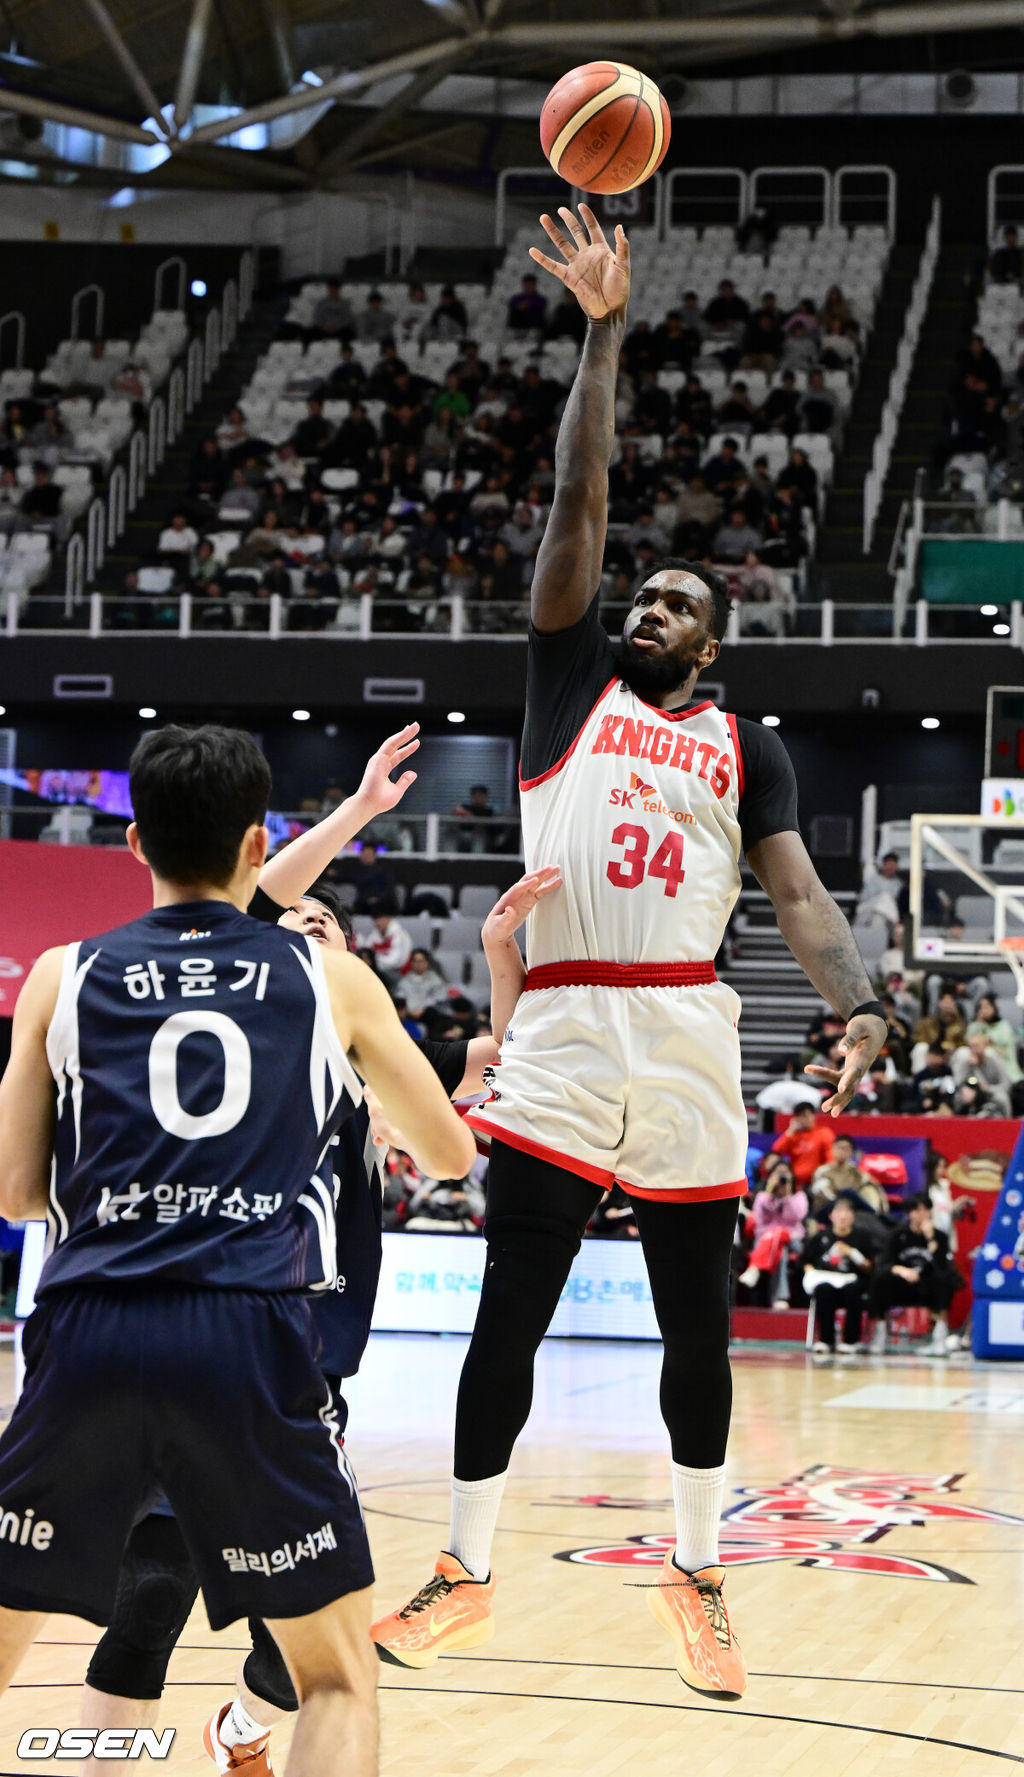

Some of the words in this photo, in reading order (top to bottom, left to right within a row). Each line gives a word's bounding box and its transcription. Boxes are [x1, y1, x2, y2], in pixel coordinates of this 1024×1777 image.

[591, 713, 732, 799] KNIGHTS
[608, 788, 637, 810] SK
[643, 799, 699, 826] telecom
[606, 822, 686, 898] 34
[123, 957, 271, 1001] 하윤기
[148, 1010, 252, 1140] 0
[0, 1506, 54, 1550] nie
